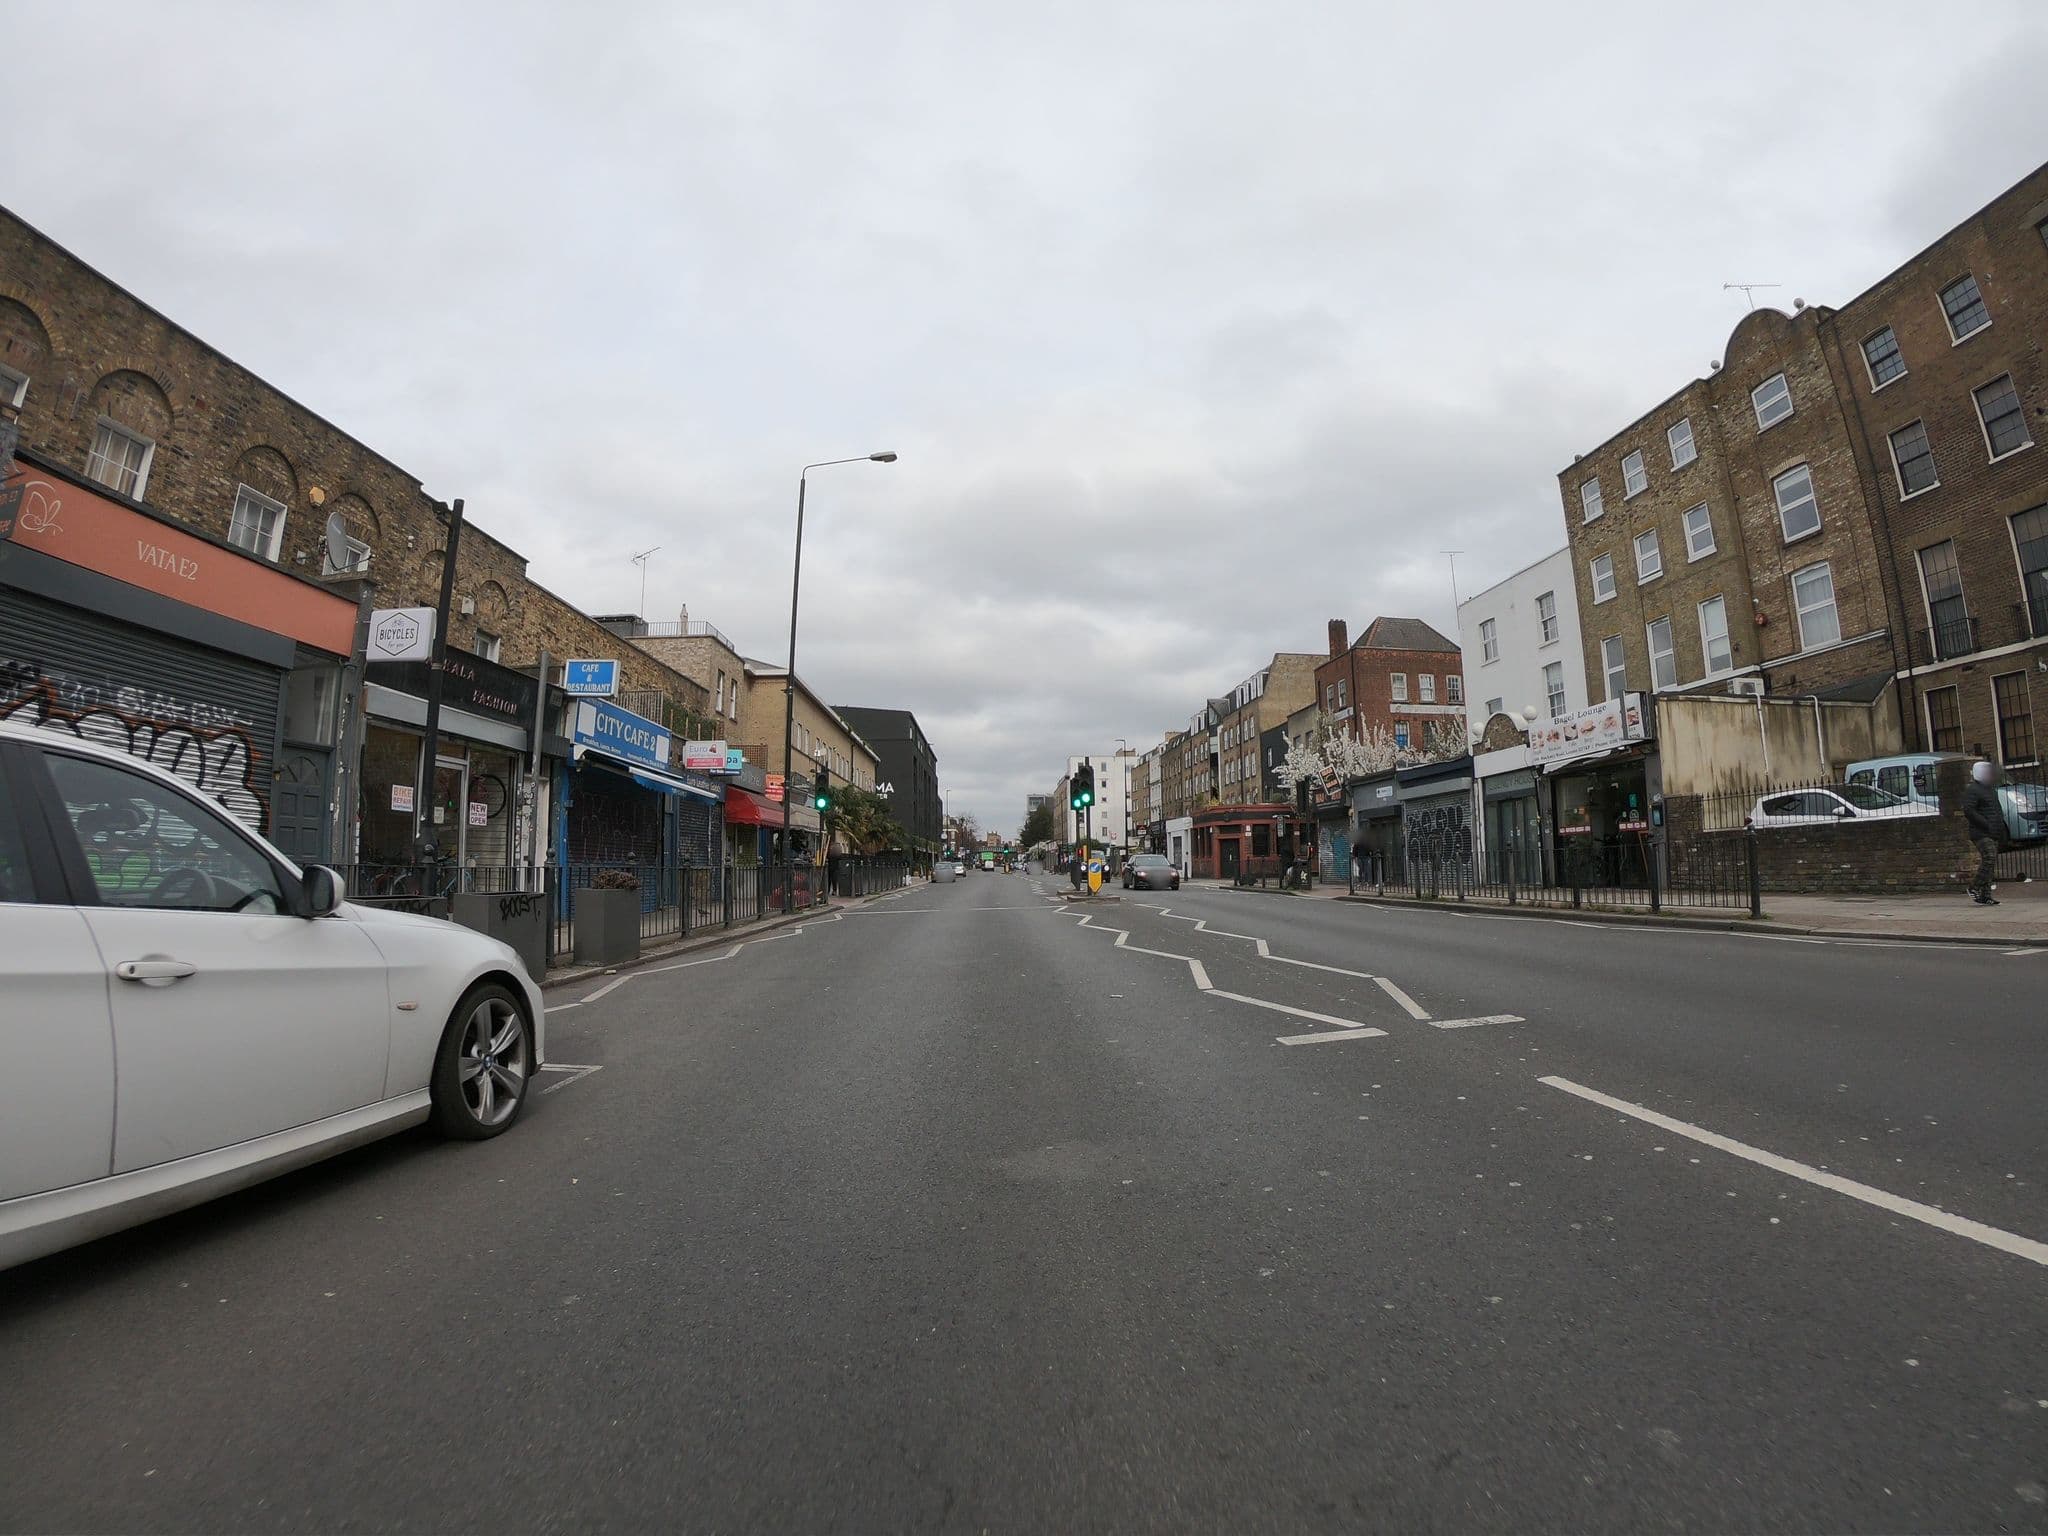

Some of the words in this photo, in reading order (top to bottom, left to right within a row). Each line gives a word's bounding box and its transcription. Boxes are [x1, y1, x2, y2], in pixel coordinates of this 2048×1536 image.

[137, 540, 176, 574] VATA
[179, 558, 199, 580] E2
[380, 628, 414, 640] BICYCLES
[582, 664, 599, 672] CAFE
[567, 683, 611, 692] RESTAURANT
[473, 689, 518, 715] FASHION
[1554, 713, 1576, 726] Bagel
[1577, 704, 1607, 720] Lounge
[596, 712, 624, 739] CITY
[623, 724, 650, 750] CAFE
[650, 735, 657, 752] 2
[689, 745, 708, 753] Euro
[393, 787, 411, 797] BIKE
[471, 803, 486, 813] NEW
[471, 816, 485, 825] OPEN
